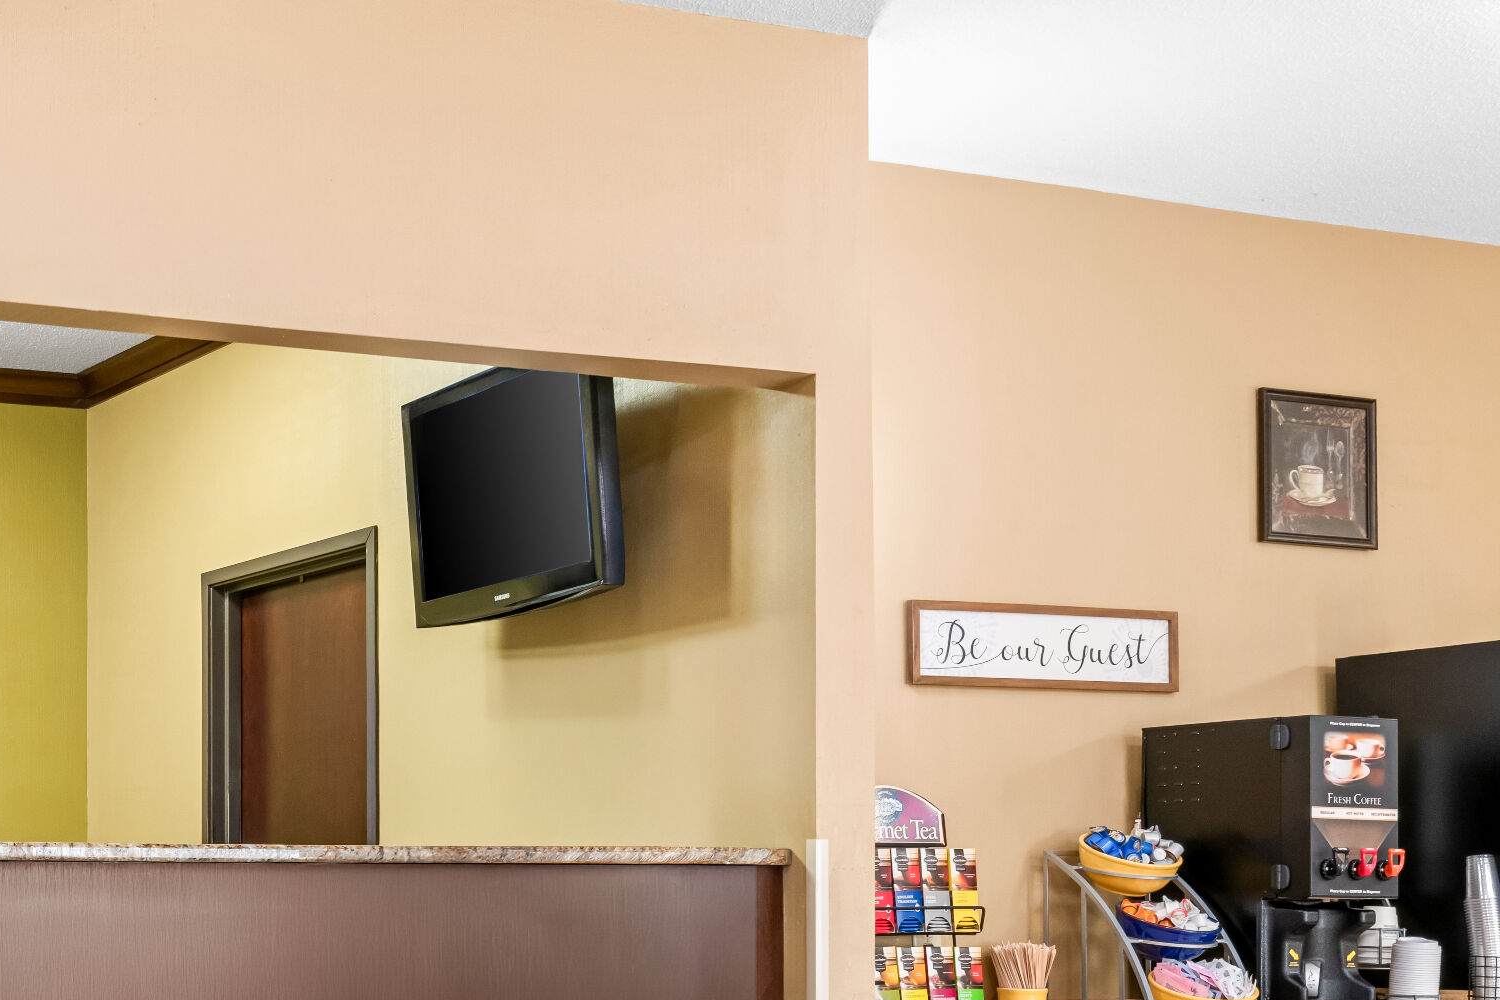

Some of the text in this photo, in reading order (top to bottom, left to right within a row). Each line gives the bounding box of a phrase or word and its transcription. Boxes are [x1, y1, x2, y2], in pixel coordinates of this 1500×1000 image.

[932, 619, 1162, 674] Be our Guest
[910, 819, 938, 840] Tea
